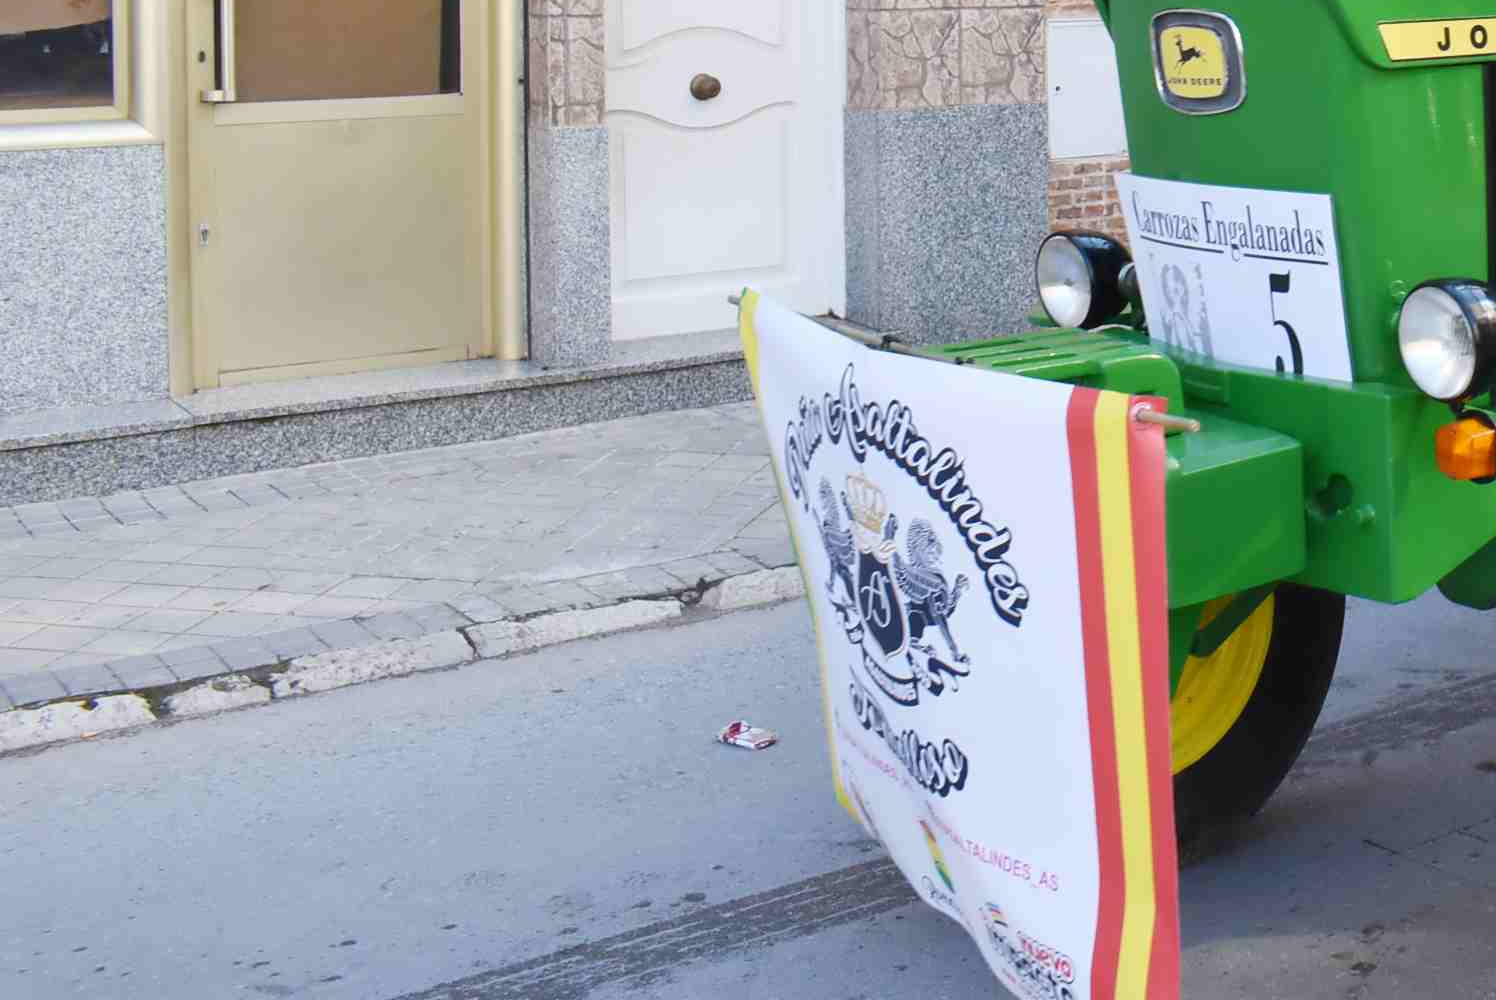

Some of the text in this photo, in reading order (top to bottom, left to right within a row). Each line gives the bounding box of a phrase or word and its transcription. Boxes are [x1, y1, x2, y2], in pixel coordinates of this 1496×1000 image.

[1131, 190, 1326, 262] Carrozas Engalanadas
[1268, 269, 1304, 377] 5
